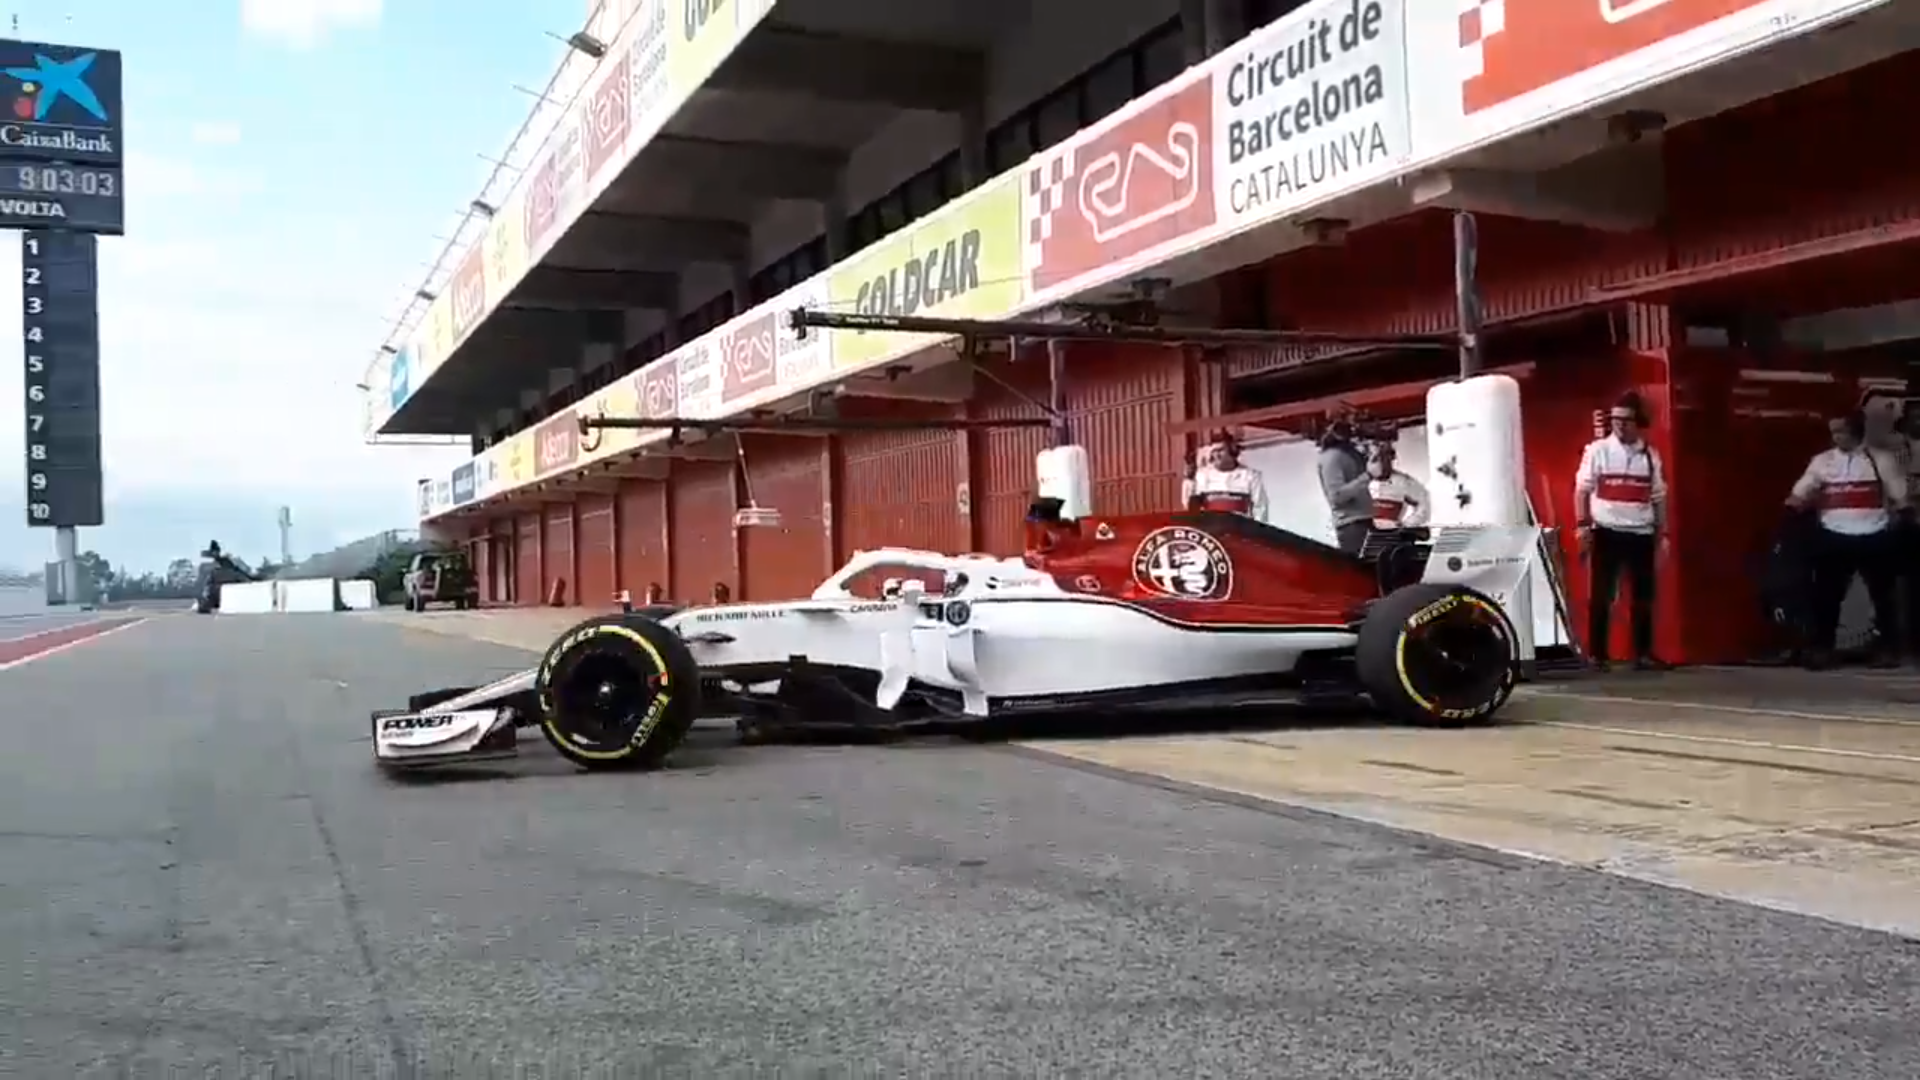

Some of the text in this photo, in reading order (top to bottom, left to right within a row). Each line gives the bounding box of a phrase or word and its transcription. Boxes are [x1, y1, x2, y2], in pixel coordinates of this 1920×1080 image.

[1227, 0, 1382, 107] Circuit de
[1229, 64, 1384, 164] Barcelona
[1, 125, 113, 153] CaixaBank
[1230, 121, 1389, 214] CATALUNYA
[0, 199, 66, 217] VOLTA
[26, 239, 38, 255] 1
[26, 268, 41, 285] 2
[856, 229, 981, 318] GOLDCAR
[28, 297, 42, 314] 3
[28, 327, 44, 342] 4
[29, 356, 43, 372] 5
[29, 385, 45, 401] 6
[30, 415, 44, 431] 7
[31, 444, 46, 460] 8
[32, 474, 47, 490] 9
[31, 503, 49, 519] 10
[1137, 529, 1227, 575] ALFA ROMEO
[382, 714, 453, 731] POWER
